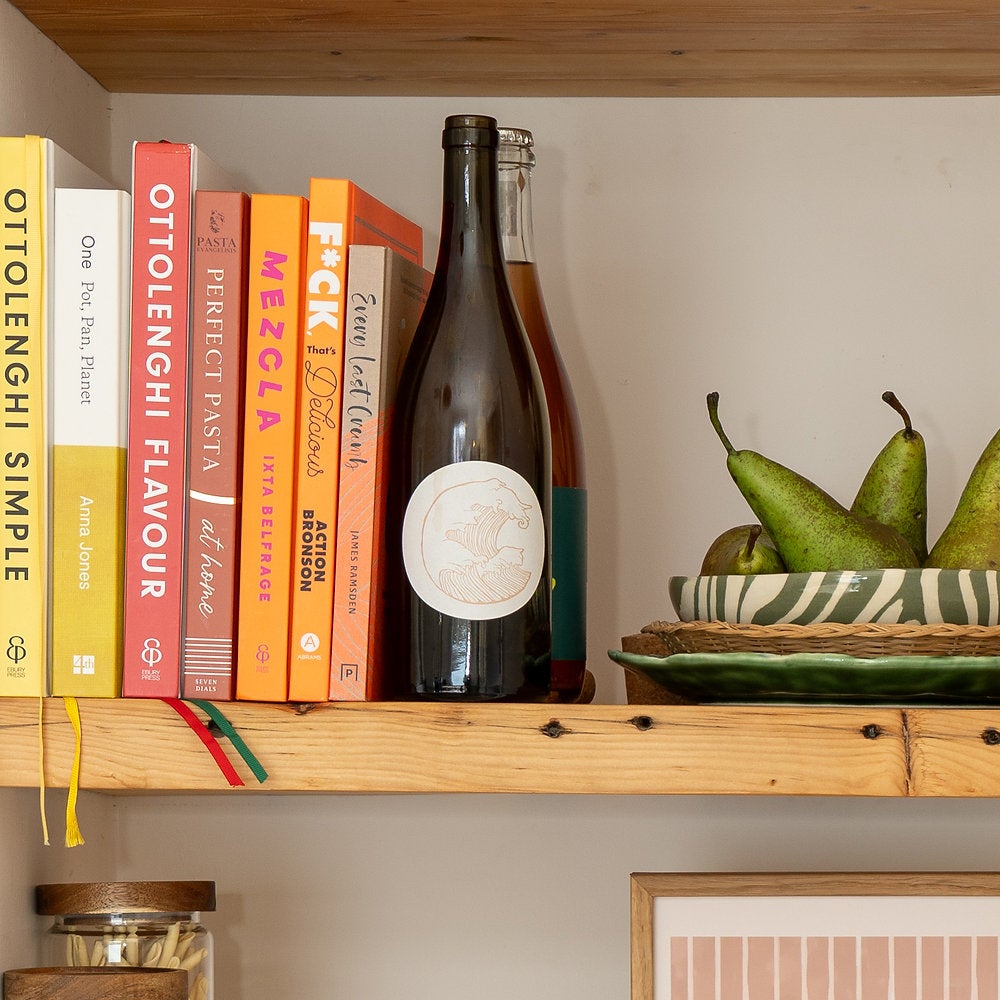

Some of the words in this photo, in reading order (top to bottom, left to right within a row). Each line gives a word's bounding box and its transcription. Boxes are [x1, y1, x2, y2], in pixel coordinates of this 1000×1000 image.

[81, 235, 96, 269] One
[197, 236, 237, 247] PASTA
[4, 188, 29, 428] OTTOLENGHI
[79, 281, 95, 311] Pot,
[145, 183, 175, 417] OTTOLENGHI
[349, 292, 377, 347] Every
[79, 317, 95, 350] Pan,
[204, 268, 224, 383] PERFECT
[256, 250, 288, 432] MEZCLA
[307, 345, 336, 355] That's
[80, 355, 95, 405] Planet
[202, 392, 222, 472] PASTA
[305, 360, 338, 477] Delicious
[262, 455, 275, 497] IXTA
[4, 451, 30, 581] SIMPLE
[79, 495, 94, 537] Anna
[140, 438, 169, 598] FLAVOUR
[199, 518, 225, 551] at
[79, 542, 94, 590] Jones
[258, 506, 274, 602] BELFRAGE
[300, 509, 314, 592] BRONSON
[314, 520, 328, 582] ACTION
[350, 530, 359, 561] JAMES
[199, 556, 223, 618] home
[348, 565, 357, 614] RAMSDEN
